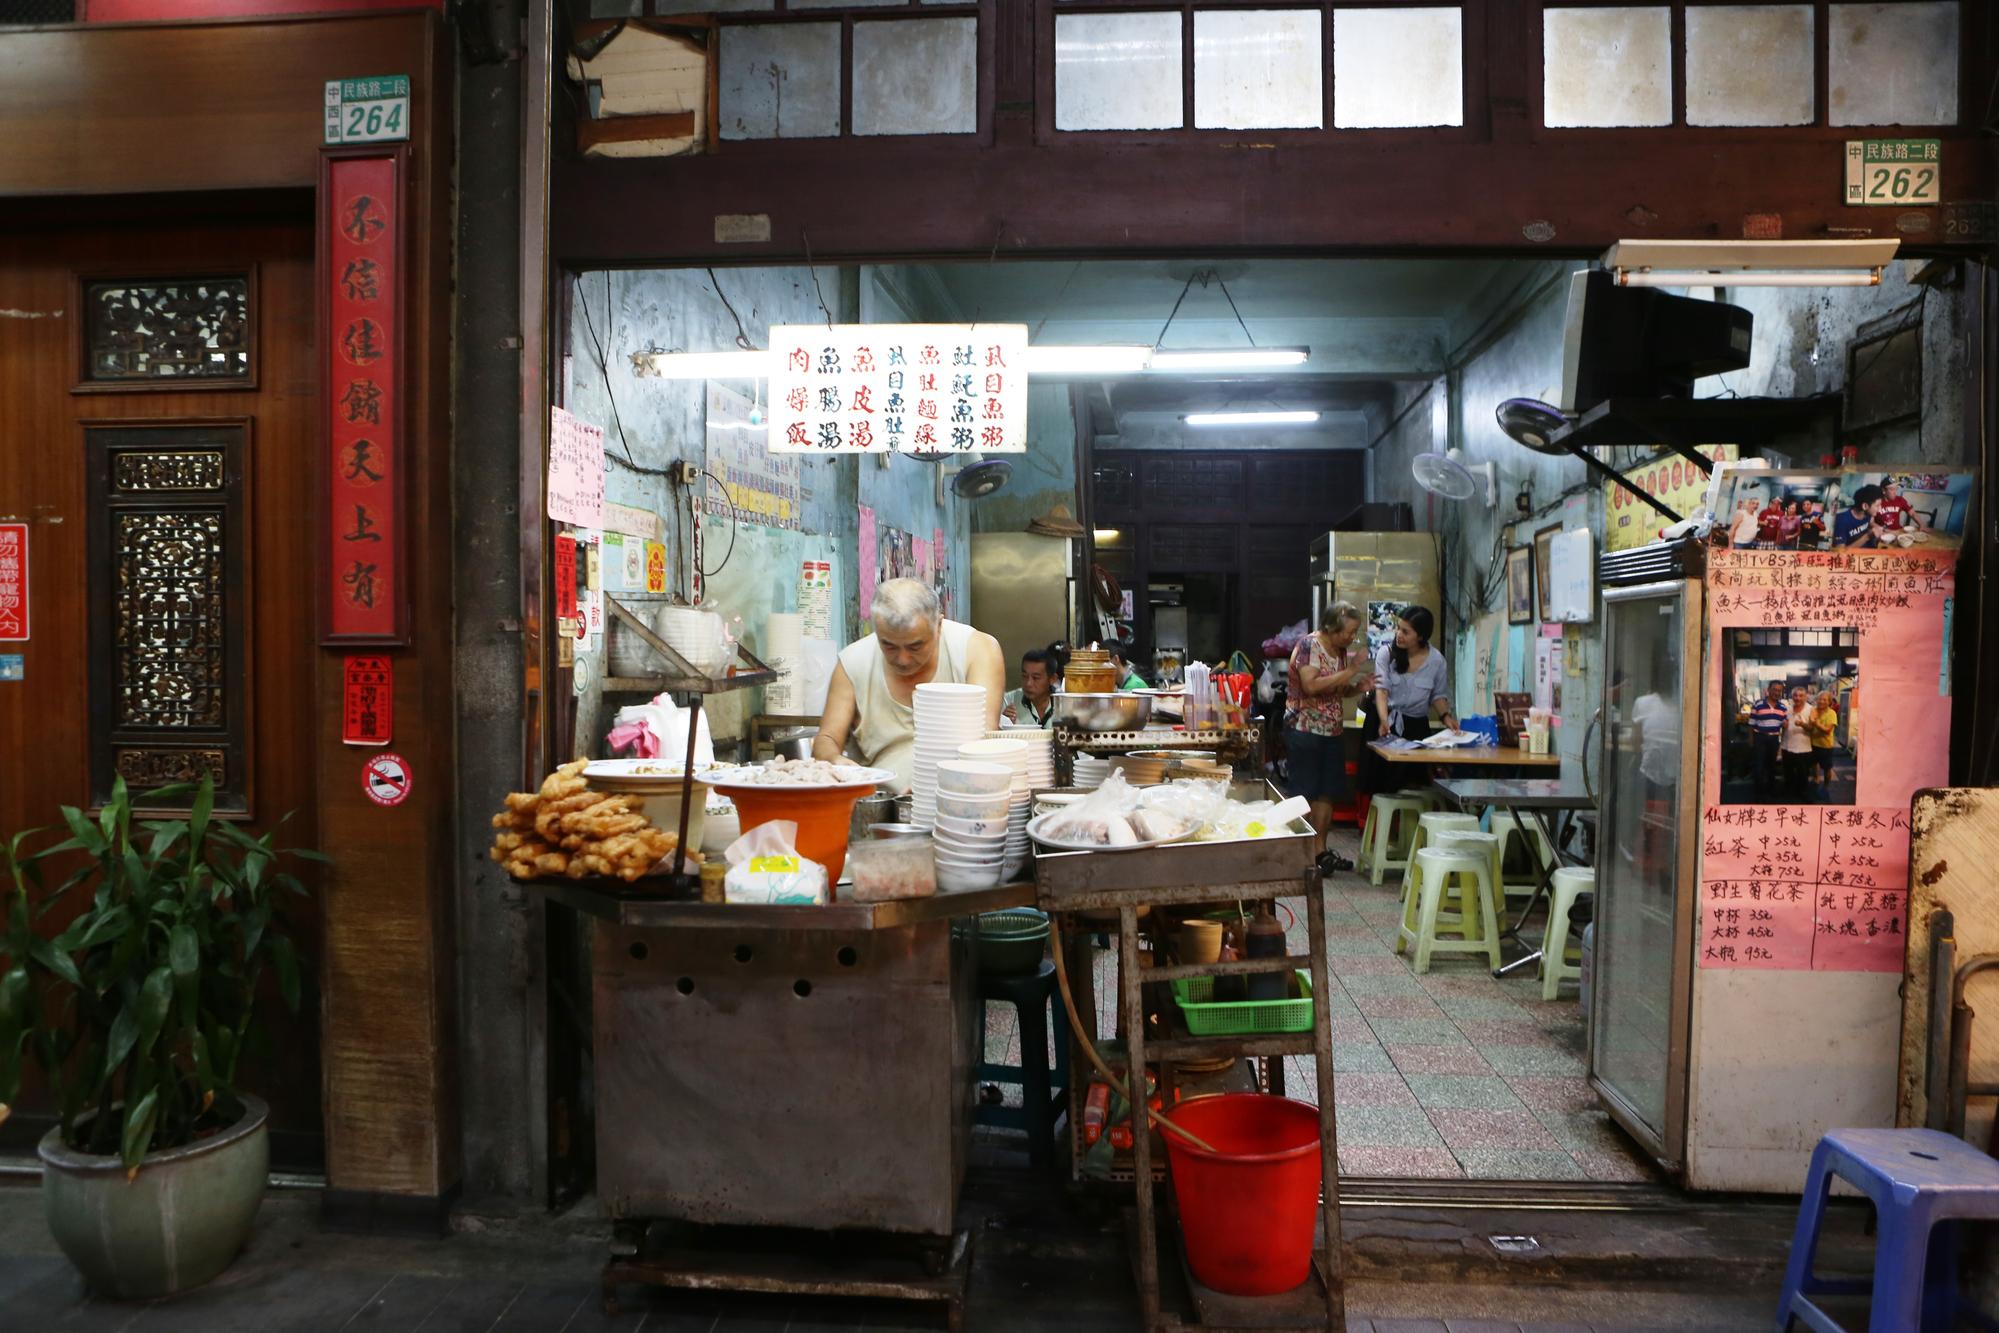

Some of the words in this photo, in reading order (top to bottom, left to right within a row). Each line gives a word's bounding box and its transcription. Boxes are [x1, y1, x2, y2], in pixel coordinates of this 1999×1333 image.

[343, 80, 406, 98] 民族路二段
[327, 87, 340, 138] 中西區
[346, 103, 402, 136] 264
[1866, 143, 1938, 160] 民族路二段
[1869, 168, 1934, 198] 262
[848, 346, 876, 447] 魚皮湯
[981, 344, 1006, 447] 虱目魚粥
[1704, 807, 1809, 828] 仙女牌古早味
[1824, 809, 1911, 831] 黑糖冬瓜
[1705, 834, 1749, 858] 紅茶
[1758, 835, 1770, 850] 中
[1829, 833, 1841, 849] 中
[1757, 852, 1771, 863] 大
[1828, 851, 1841, 866] 大
[1710, 880, 1805, 902] 野生菊花茶
[1713, 908, 1740, 924] 中杯
[1710, 925, 1740, 940] 大杯
[1704, 944, 1738, 961] 大瓶
[1744, 946, 1773, 961] 95元
